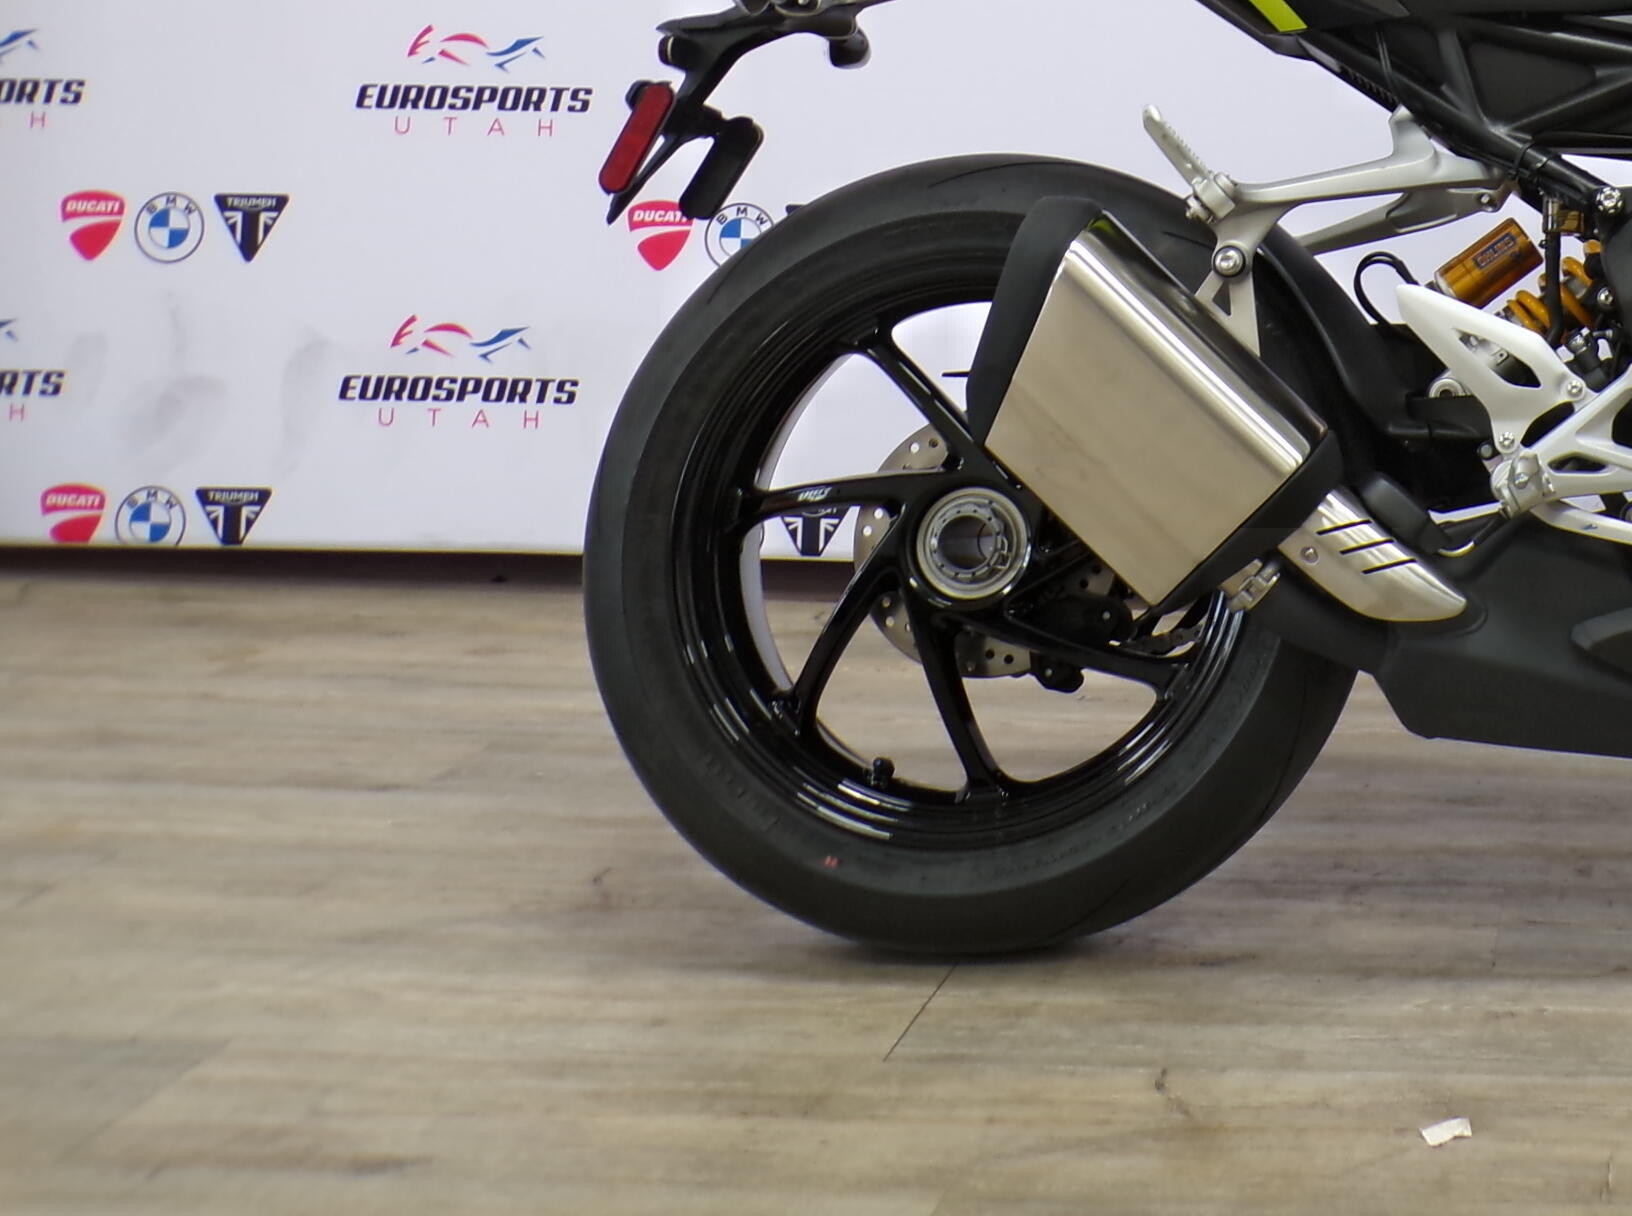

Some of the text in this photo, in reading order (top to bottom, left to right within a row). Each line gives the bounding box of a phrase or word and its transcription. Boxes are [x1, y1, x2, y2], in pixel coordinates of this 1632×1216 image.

[356, 85, 592, 112] EUROSPORTS
[393, 116, 555, 137] UTAH
[67, 199, 120, 213] DUCATI
[145, 195, 196, 213] BMW
[226, 197, 277, 208] TRIUMPH
[716, 207, 767, 225] BMW
[339, 376, 578, 404] EUROSPORTS
[375, 408, 541, 428] UTAH
[47, 493, 100, 506] DUCATI
[126, 489, 176, 508] BMW
[208, 491, 259, 502] TRIUMPH
